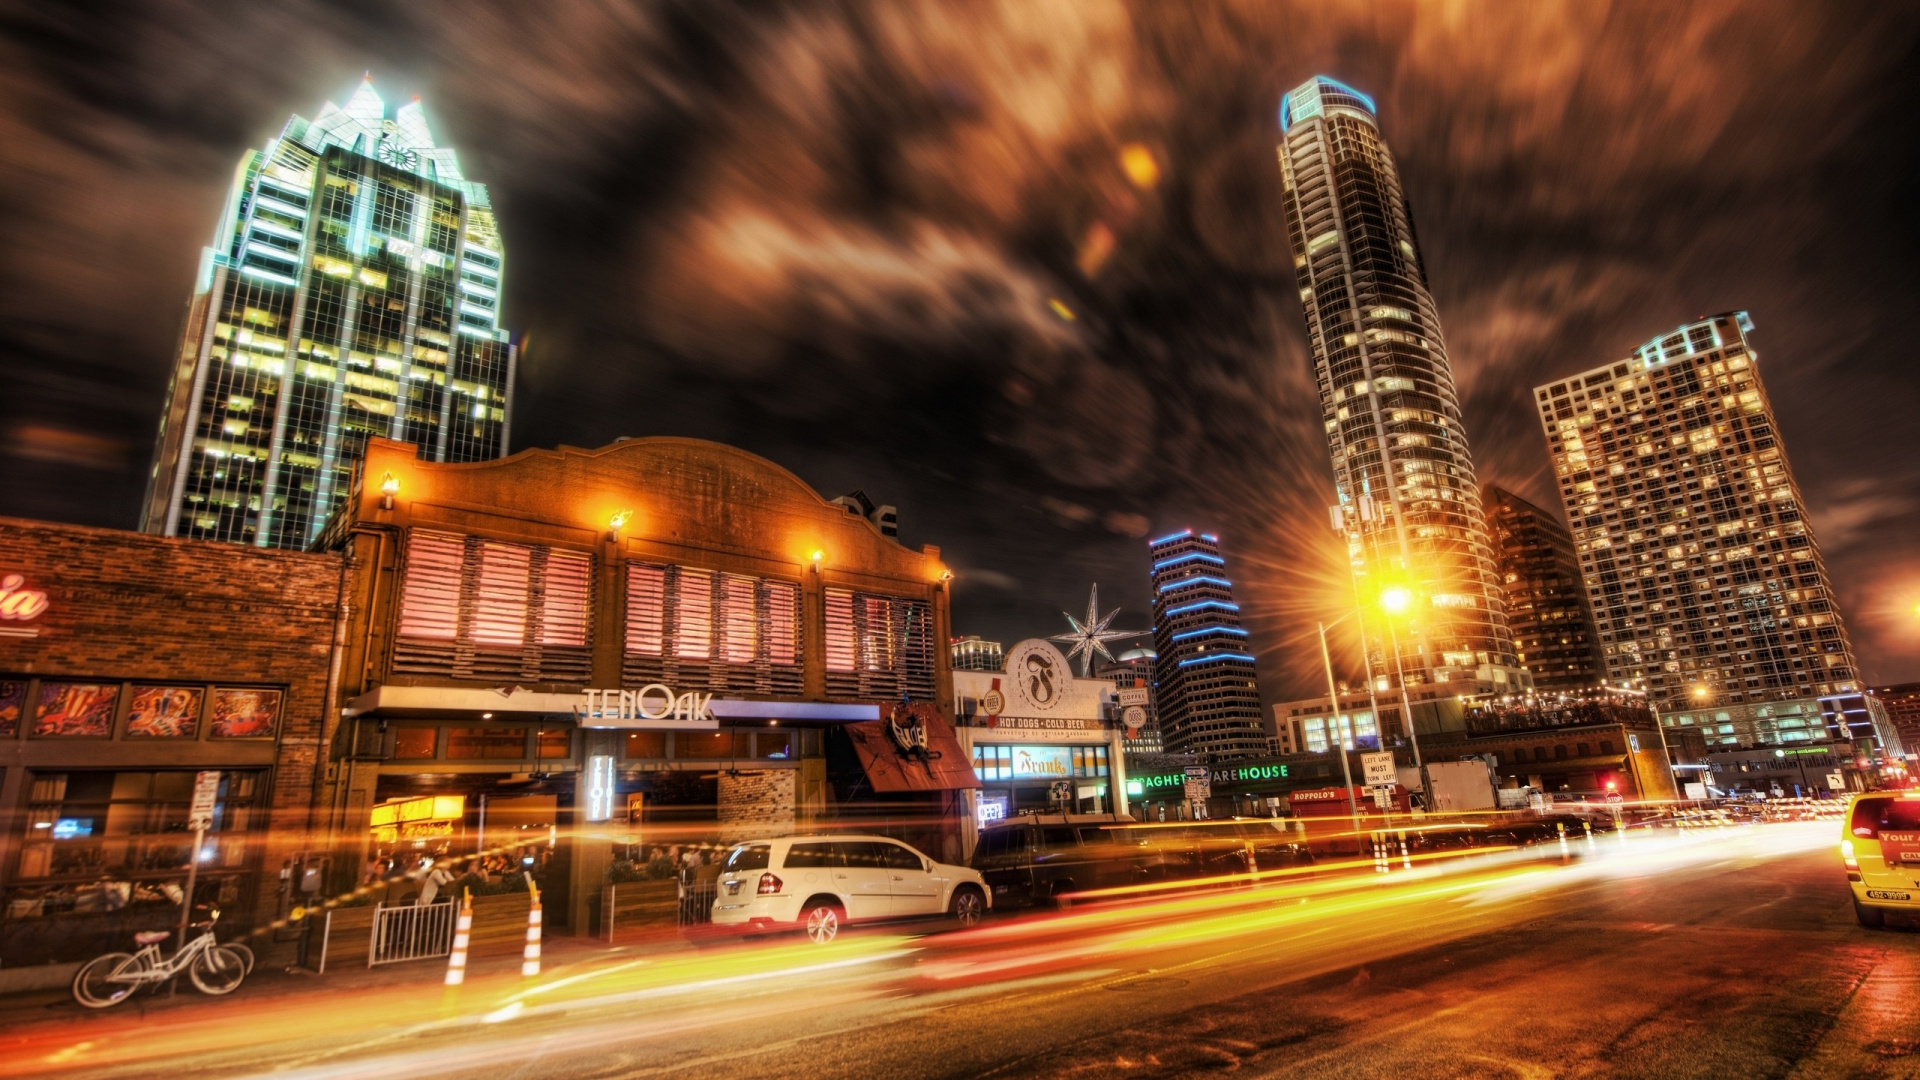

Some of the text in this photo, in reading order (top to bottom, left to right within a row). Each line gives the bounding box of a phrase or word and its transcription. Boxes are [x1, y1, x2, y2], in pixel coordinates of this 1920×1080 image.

[1122, 693, 1145, 701] COFFEE
[999, 717, 1085, 729] HOT DOGS COLD BEER
[1019, 750, 1066, 775] Frank
[1294, 791, 1335, 800] ROPPOLO'S
[979, 804, 1002, 820] OPEN
[1880, 833, 1914, 841] Your
